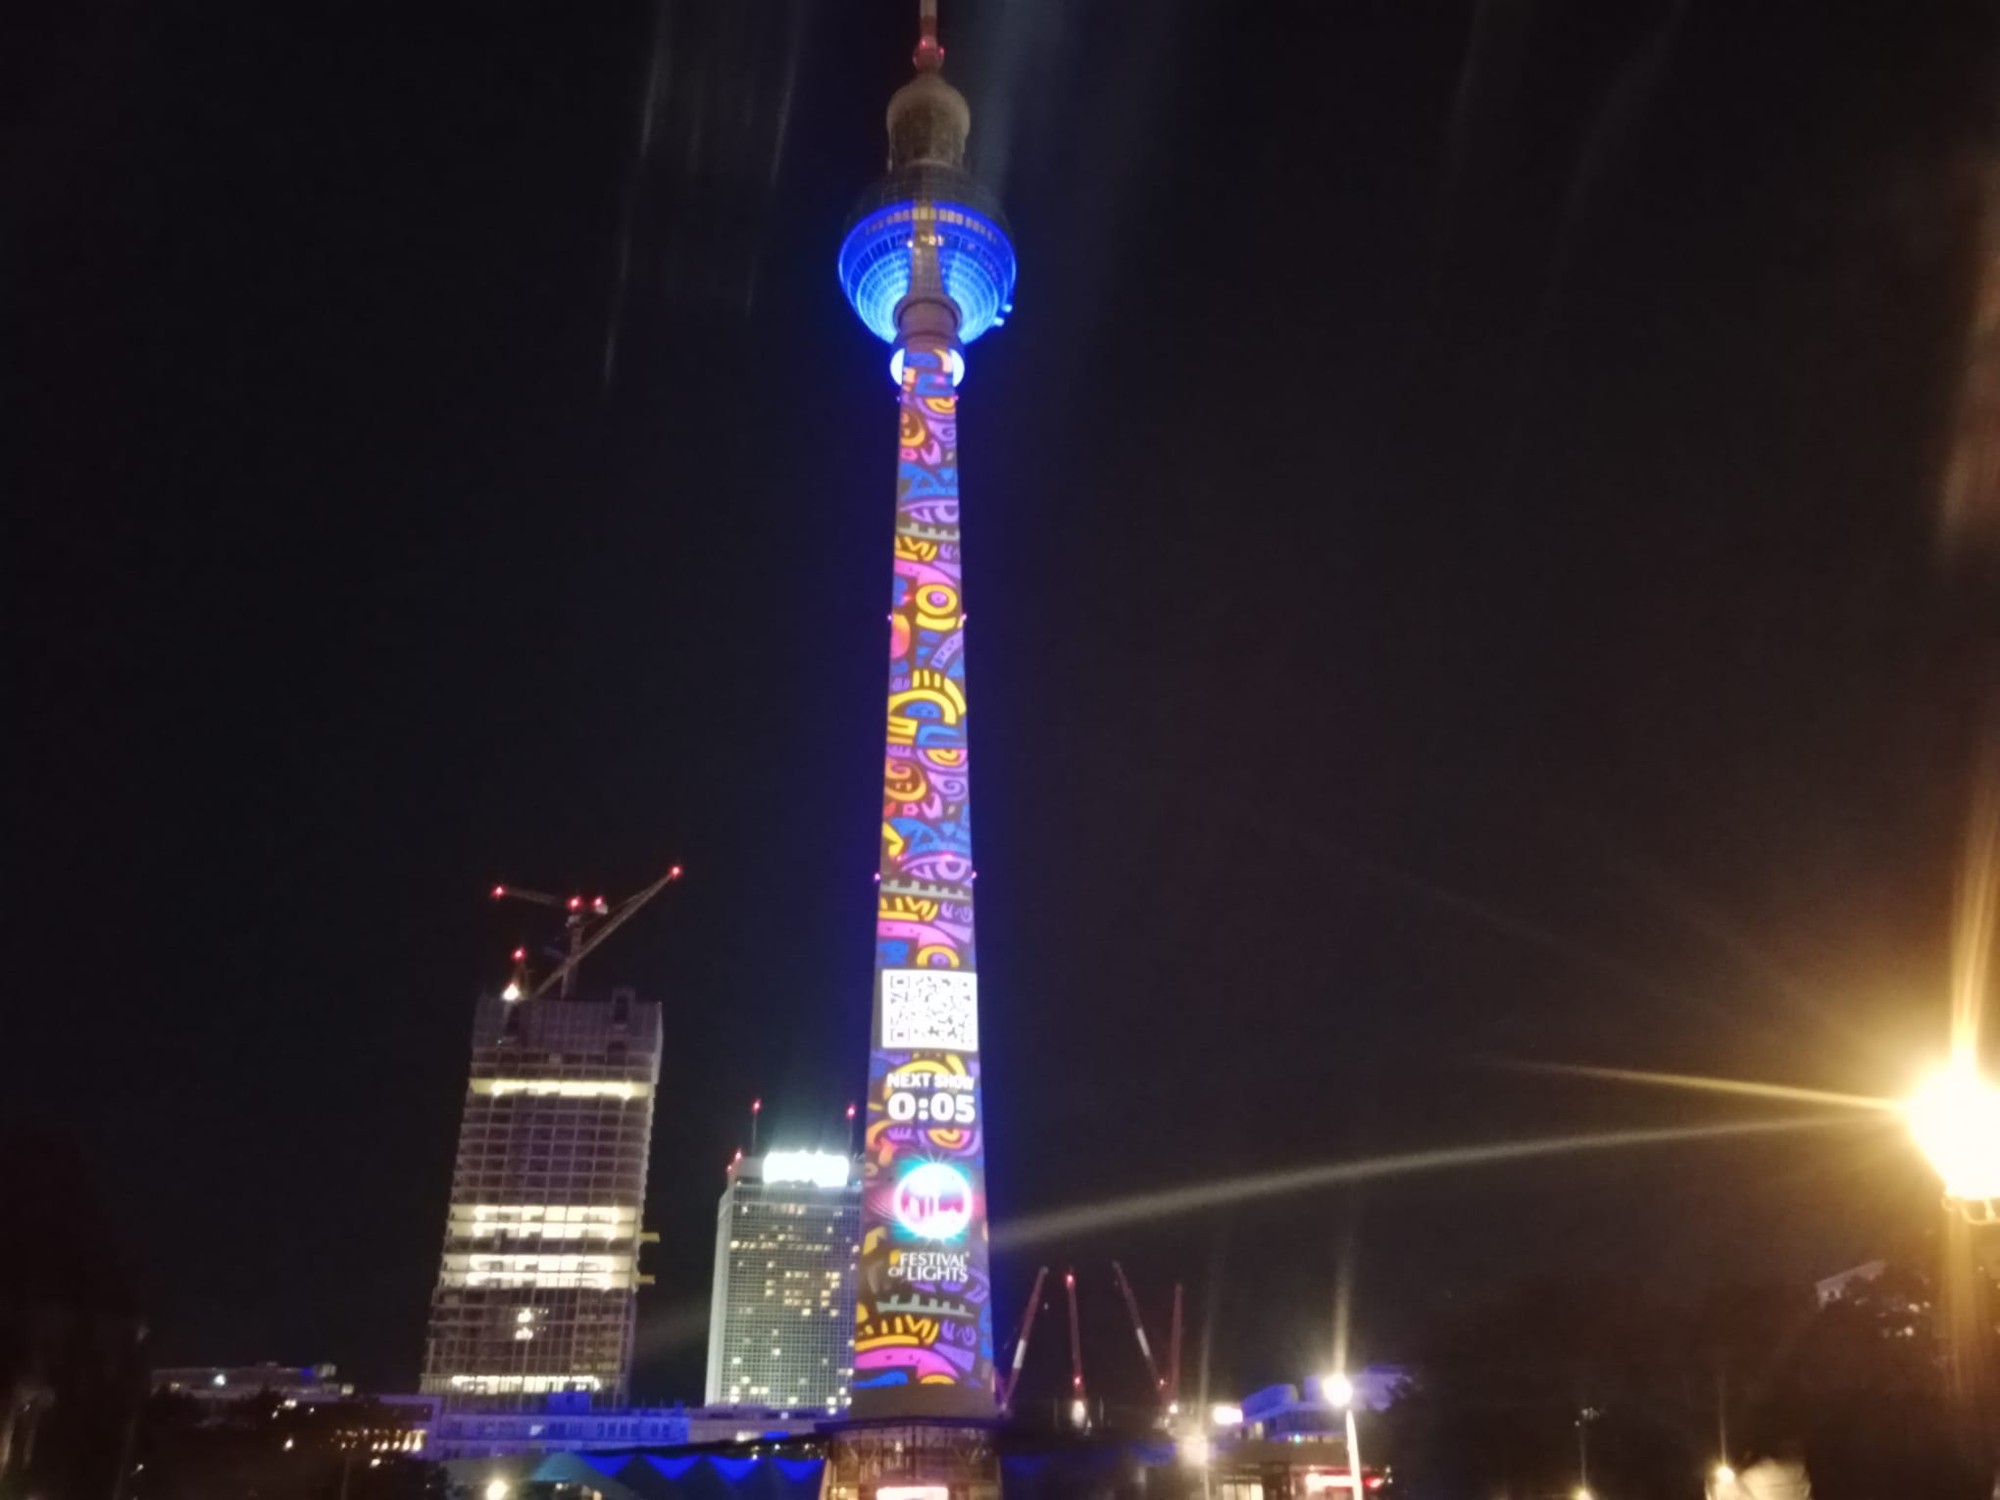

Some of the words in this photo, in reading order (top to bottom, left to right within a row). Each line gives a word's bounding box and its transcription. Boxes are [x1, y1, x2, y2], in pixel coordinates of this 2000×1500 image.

[886, 1073, 931, 1087] NEXT
[934, 1073, 974, 1090] SHOW
[888, 1092, 975, 1123] 0:05
[901, 1251, 965, 1267] FESTIVAL
[888, 1266, 904, 1277] OF
[907, 1266, 968, 1283] LIGHTS
